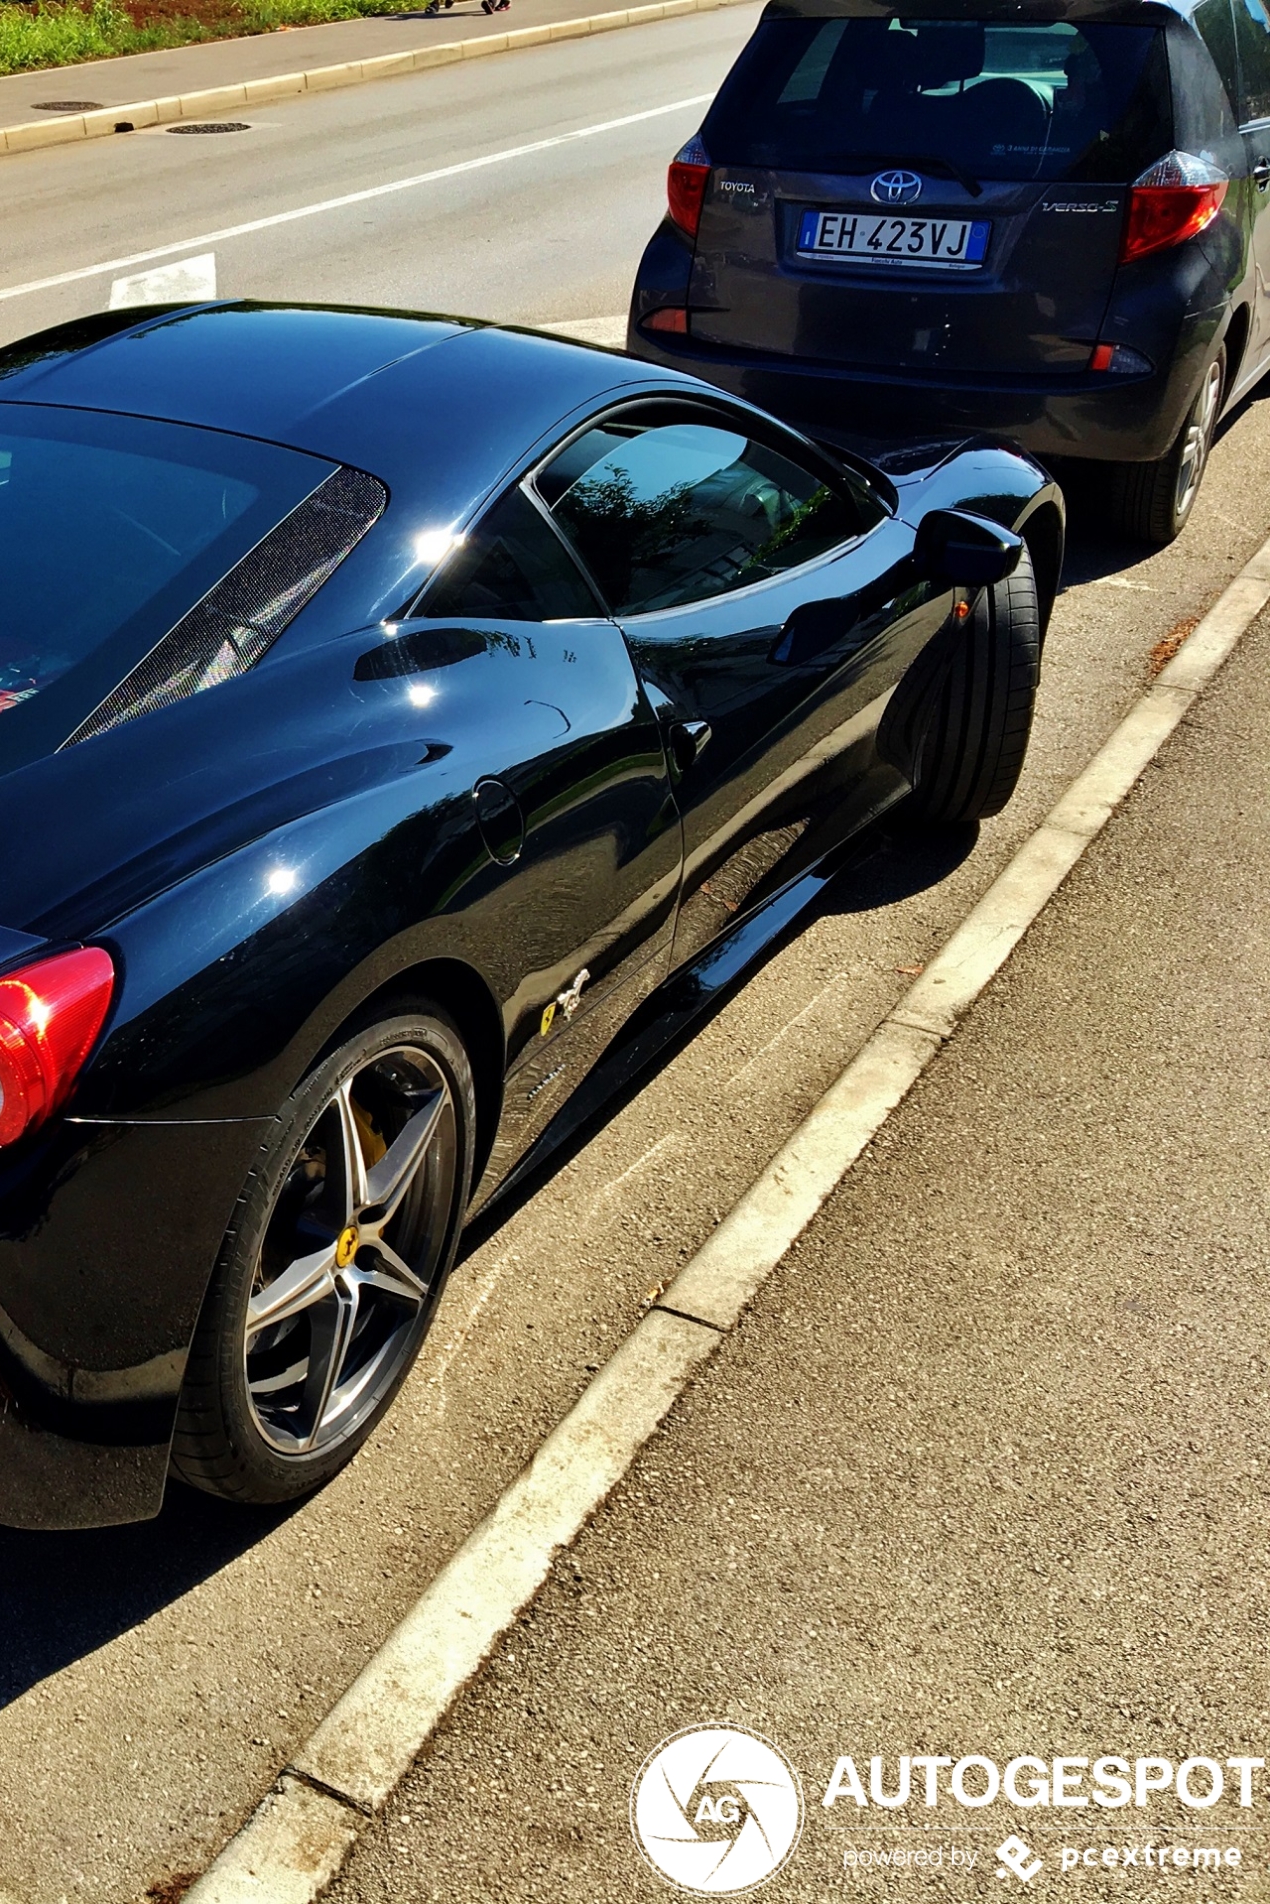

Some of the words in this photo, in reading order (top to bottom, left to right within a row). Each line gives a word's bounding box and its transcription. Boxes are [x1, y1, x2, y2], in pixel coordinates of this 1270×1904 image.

[720, 181, 755, 194] TOYOTA
[1042, 200, 1119, 213] VERSO-S
[818, 216, 858, 249] EH
[866, 219, 968, 256] 423VJ
